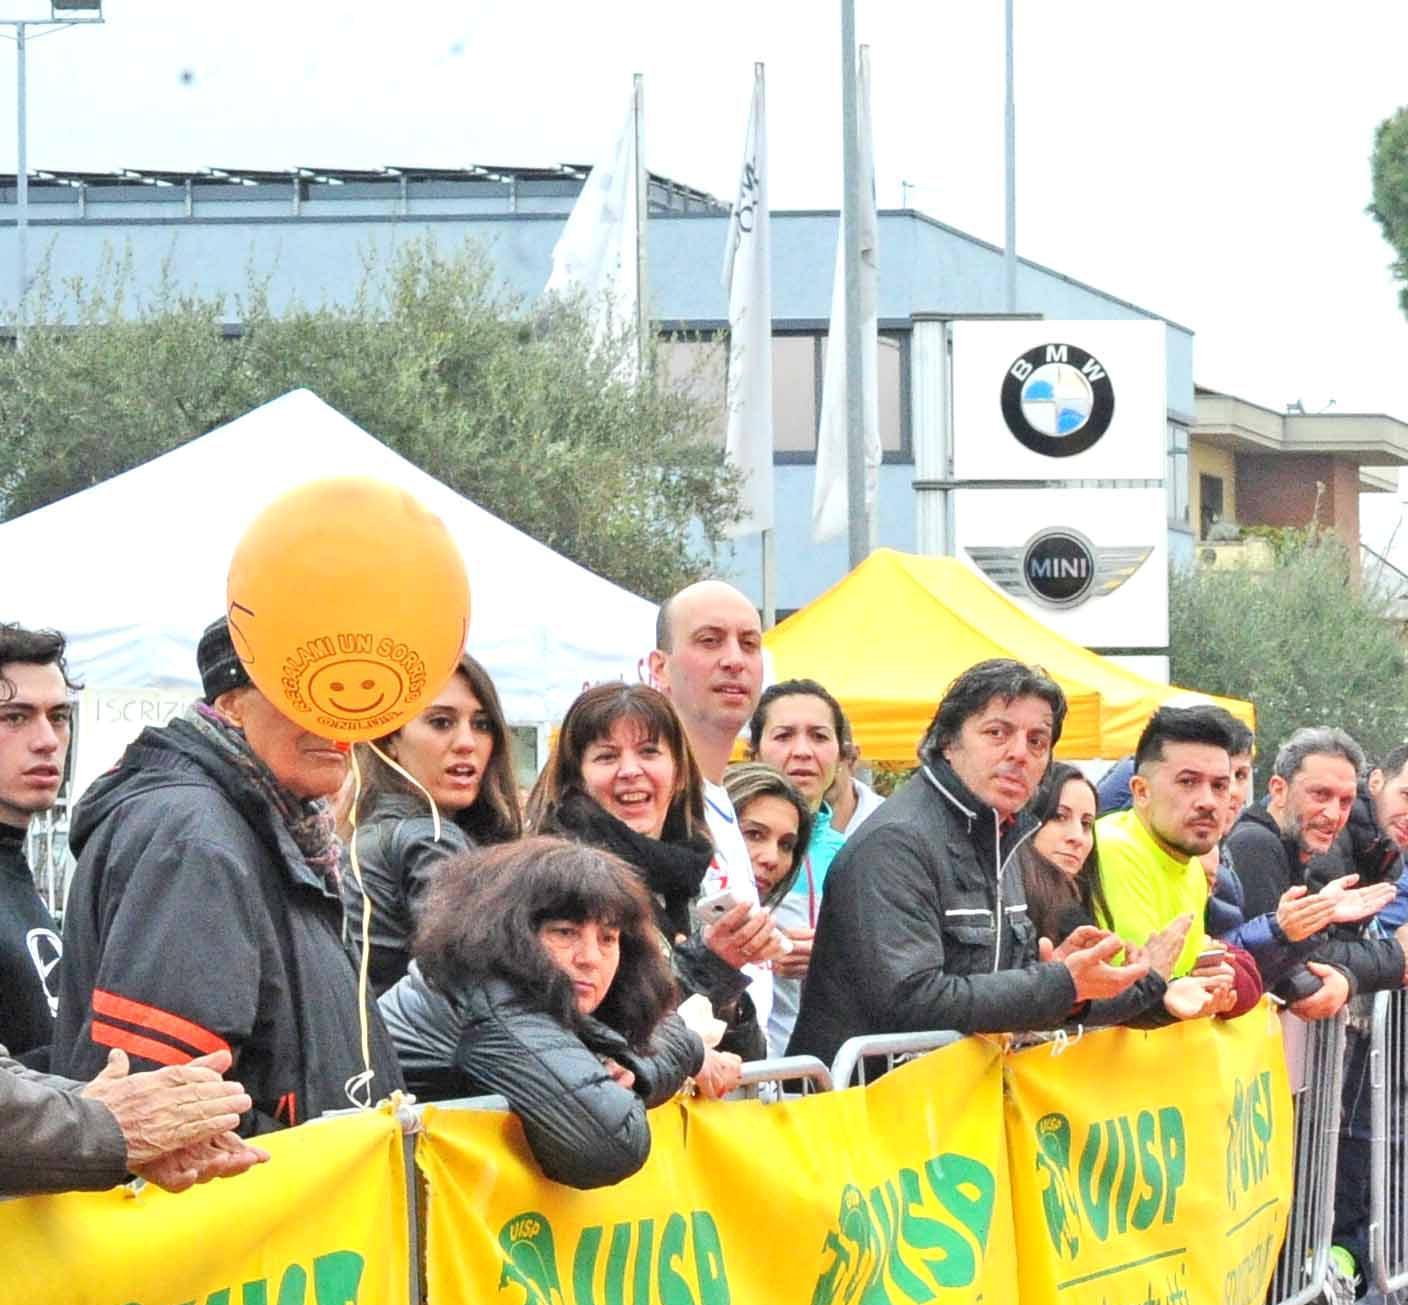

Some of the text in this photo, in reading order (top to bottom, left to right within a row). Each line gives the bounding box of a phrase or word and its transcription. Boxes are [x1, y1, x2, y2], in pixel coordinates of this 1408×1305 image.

[1010, 344, 1106, 384] BMW
[1030, 558, 1087, 579] MINI
[337, 633, 373, 655] UN
[1079, 1106, 1187, 1242] UISP
